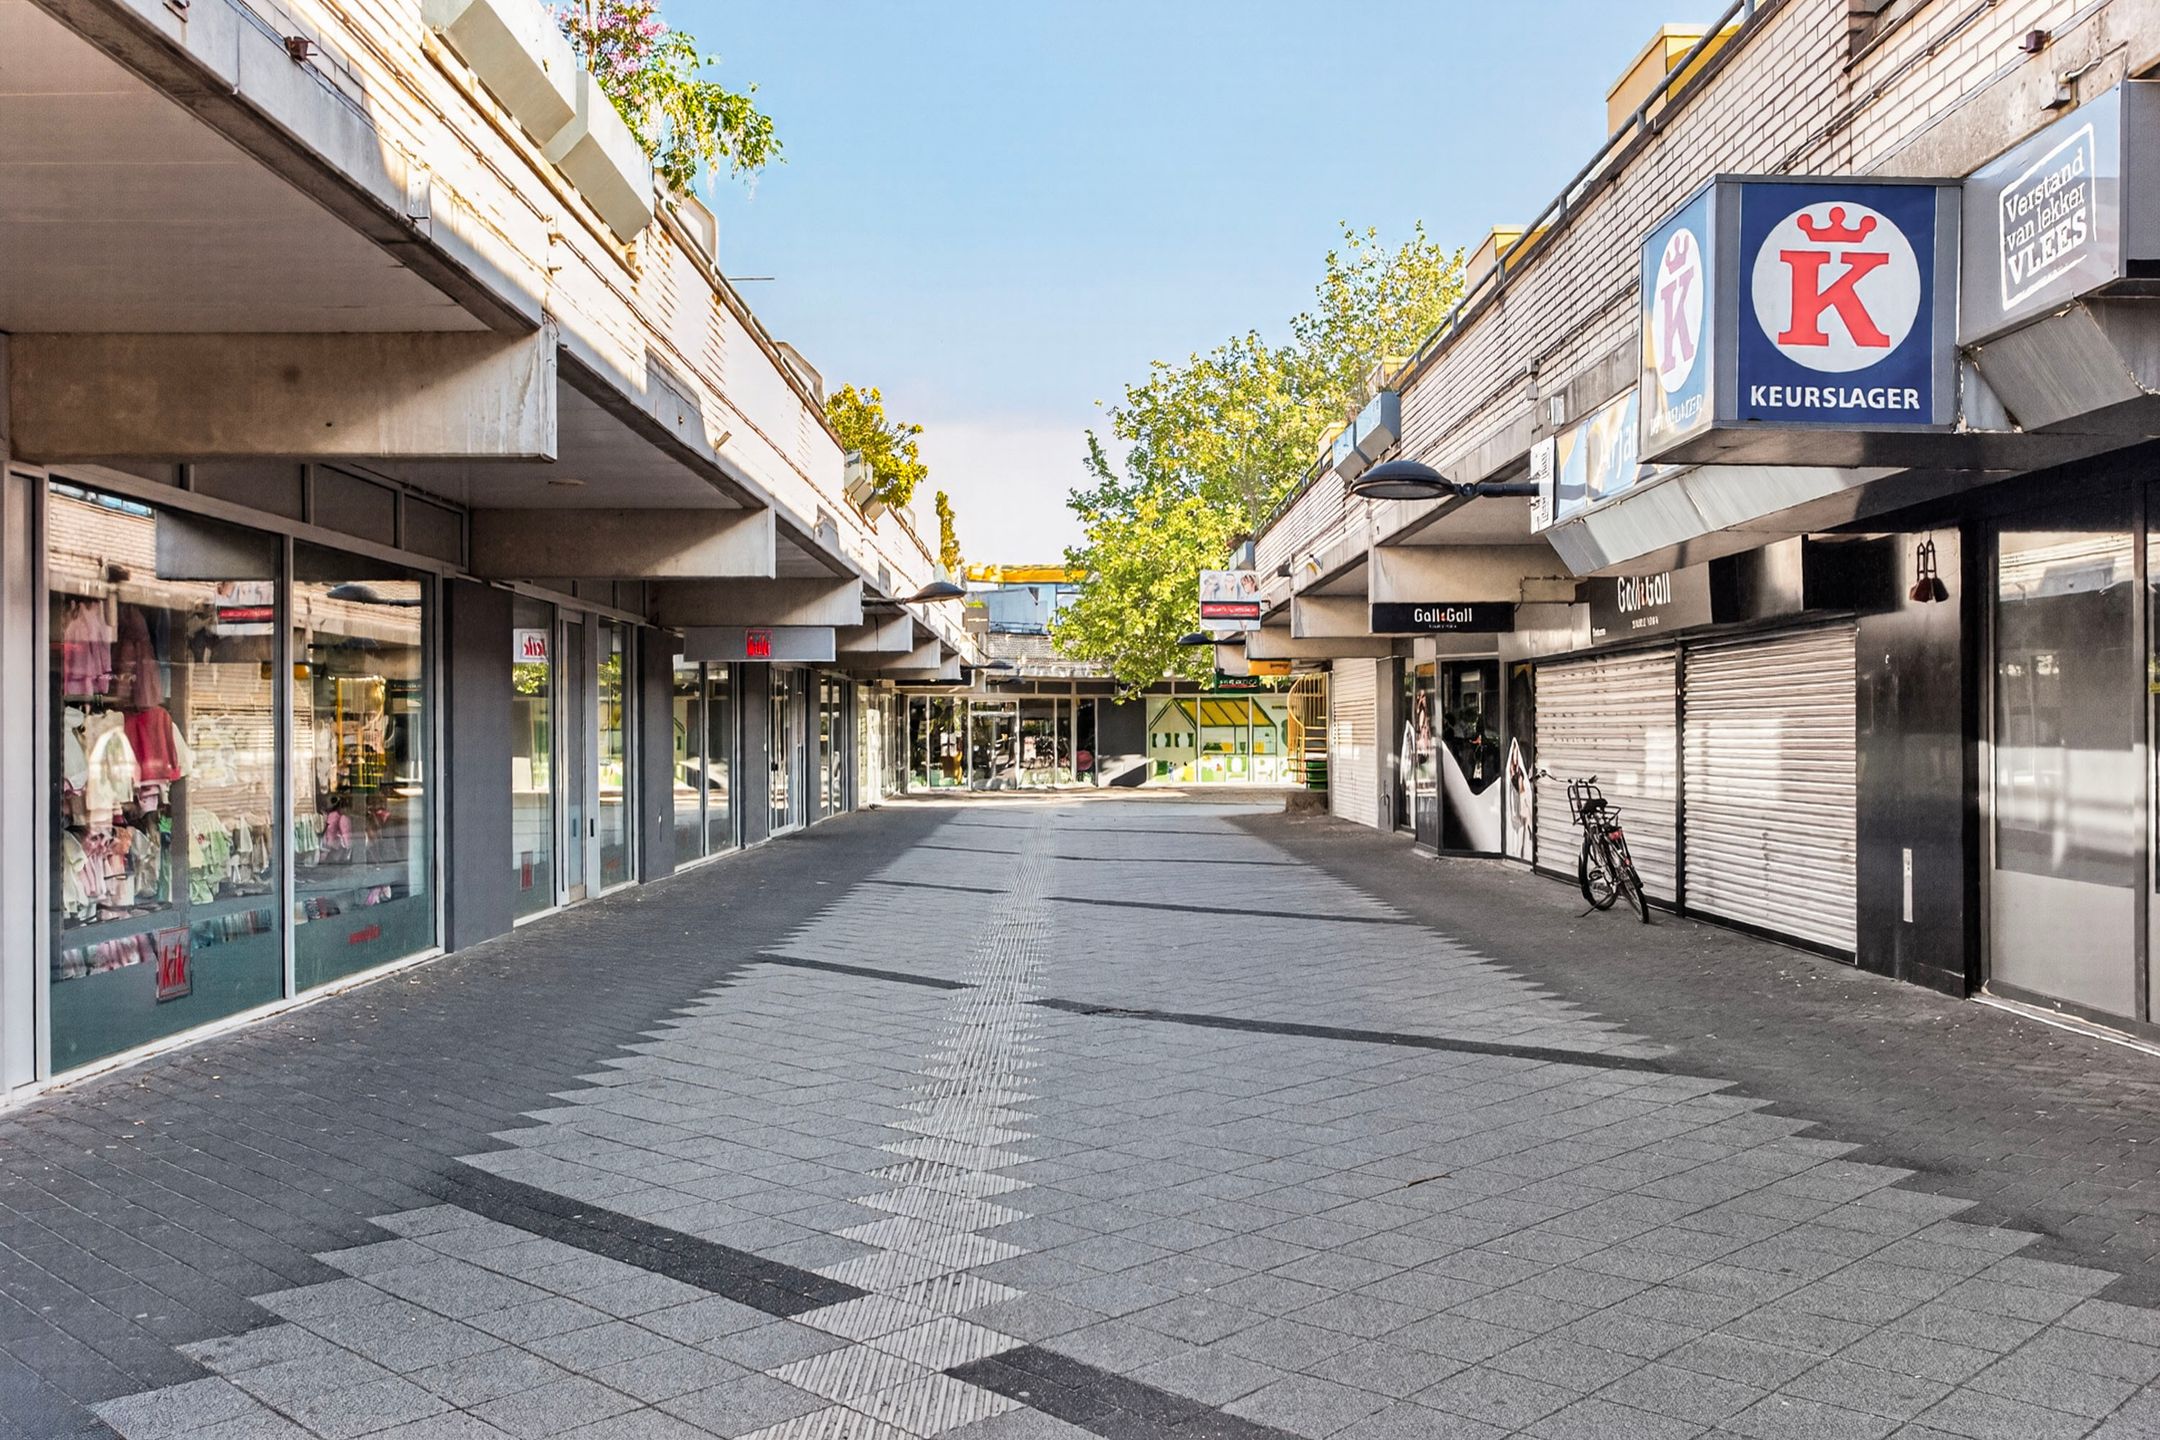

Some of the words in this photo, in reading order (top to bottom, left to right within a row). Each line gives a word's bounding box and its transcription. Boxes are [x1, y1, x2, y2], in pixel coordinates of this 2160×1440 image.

[2004, 146, 2085, 223] Verstand
[2006, 219, 2035, 252] van
[2037, 183, 2086, 233] lekker
[2008, 207, 2088, 286] VLEES
[1660, 264, 1695, 377] K
[1777, 250, 1890, 348] K
[1750, 384, 1921, 410] KEURSLAGER
